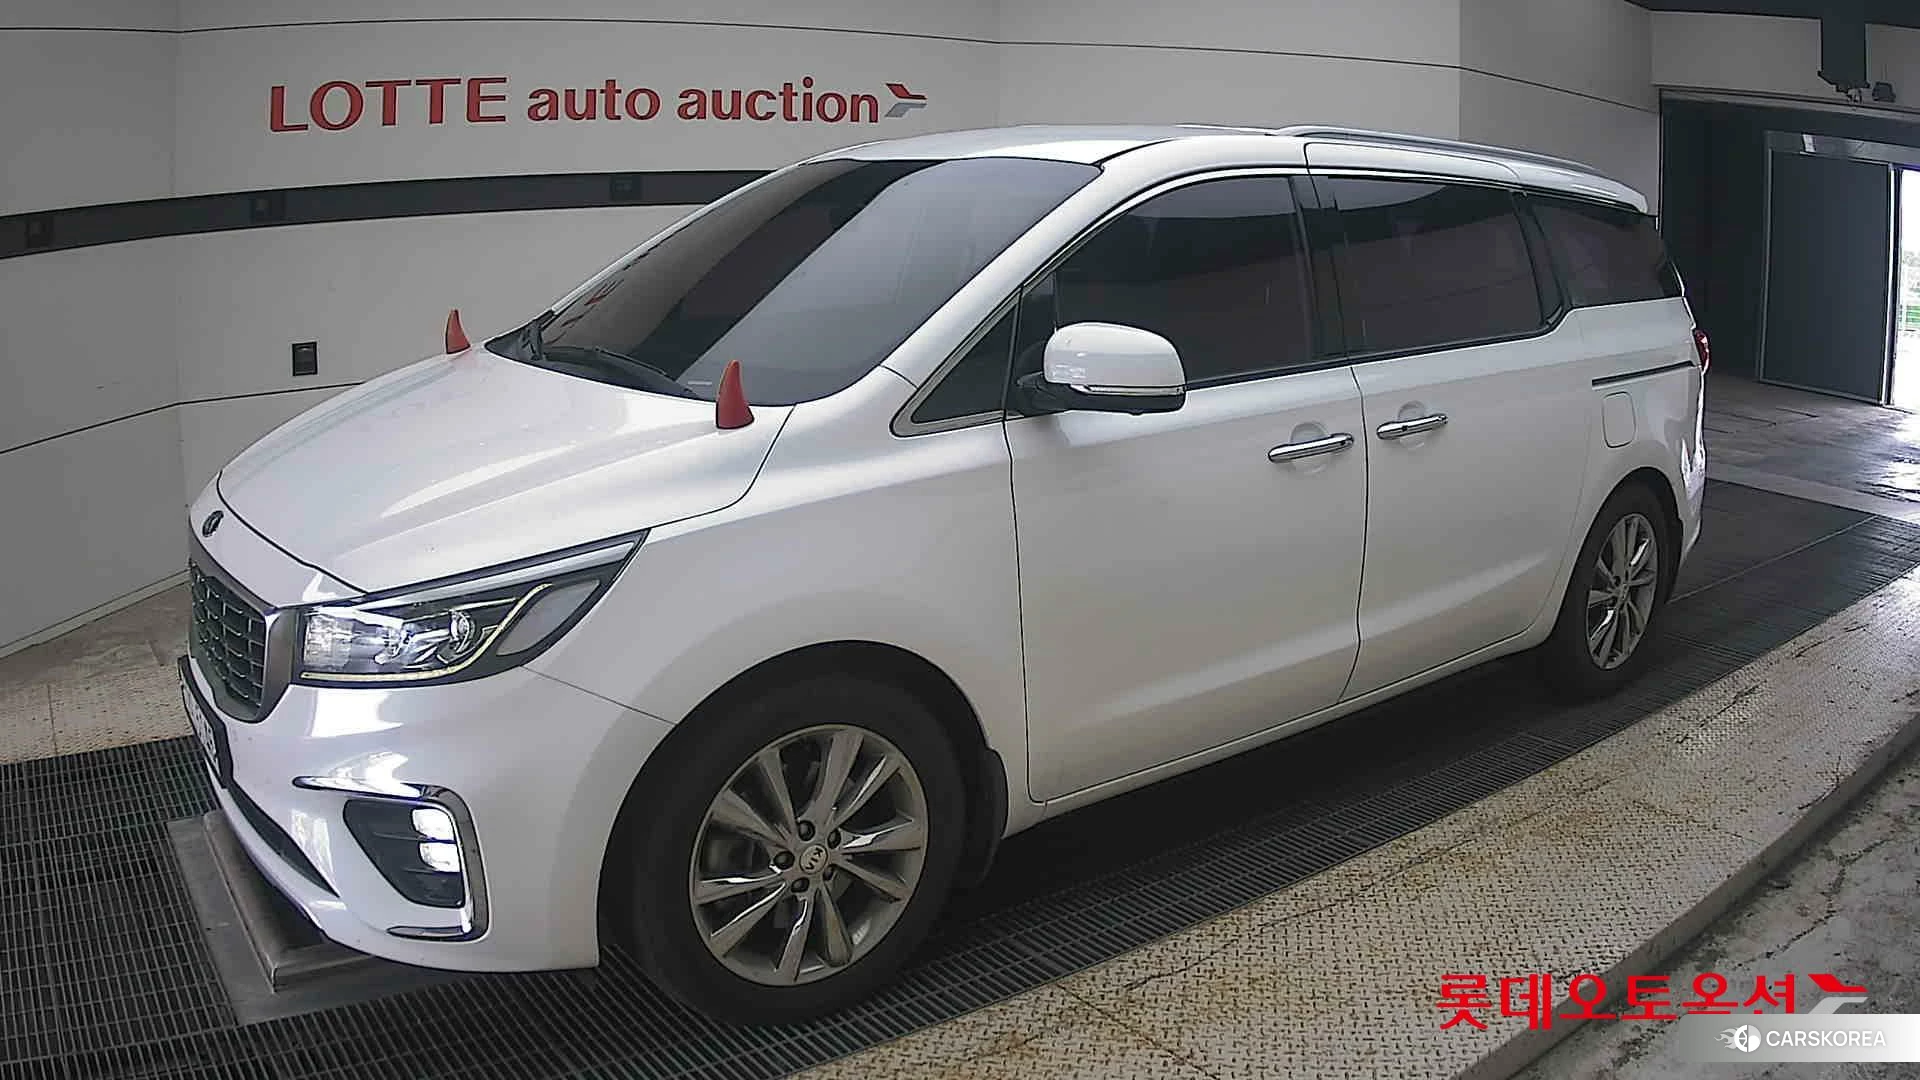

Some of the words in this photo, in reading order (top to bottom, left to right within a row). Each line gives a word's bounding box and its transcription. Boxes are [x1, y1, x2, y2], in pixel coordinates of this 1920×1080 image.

[270, 77, 507, 131] LOTTE
[527, 80, 660, 121] auto
[677, 77, 879, 124] auction
